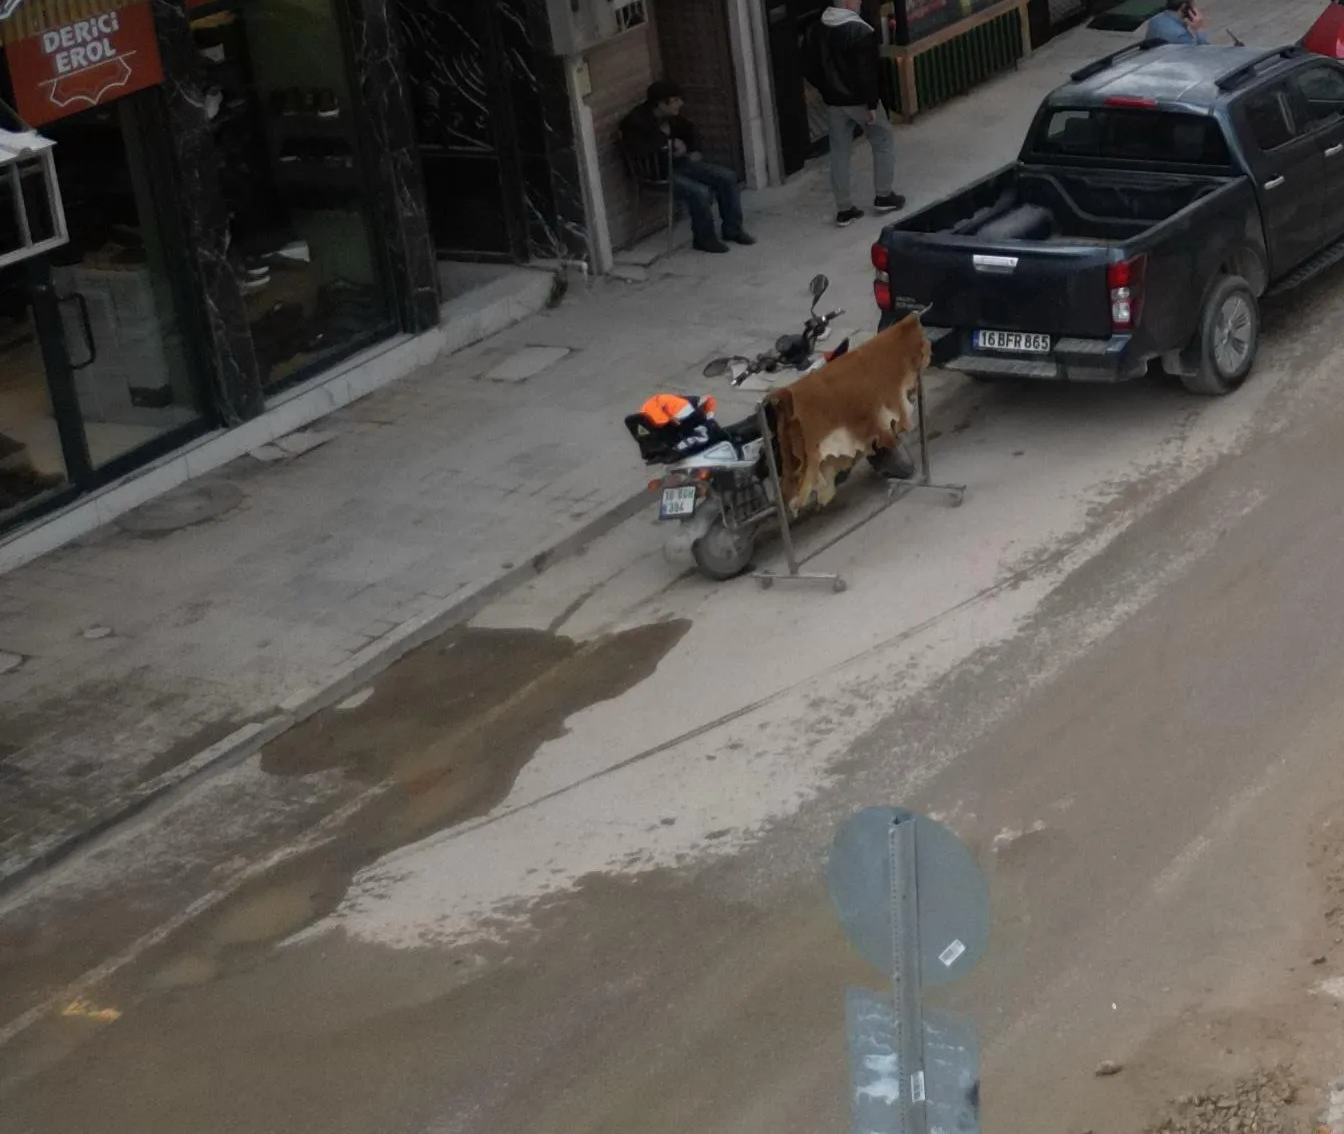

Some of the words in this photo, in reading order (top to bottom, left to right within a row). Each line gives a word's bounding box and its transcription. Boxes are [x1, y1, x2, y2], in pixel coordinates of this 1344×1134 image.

[55, 38, 117, 74] EROL
[981, 332, 996, 346] 16
[998, 333, 1021, 348] BFR
[1024, 335, 1050, 350] 865
